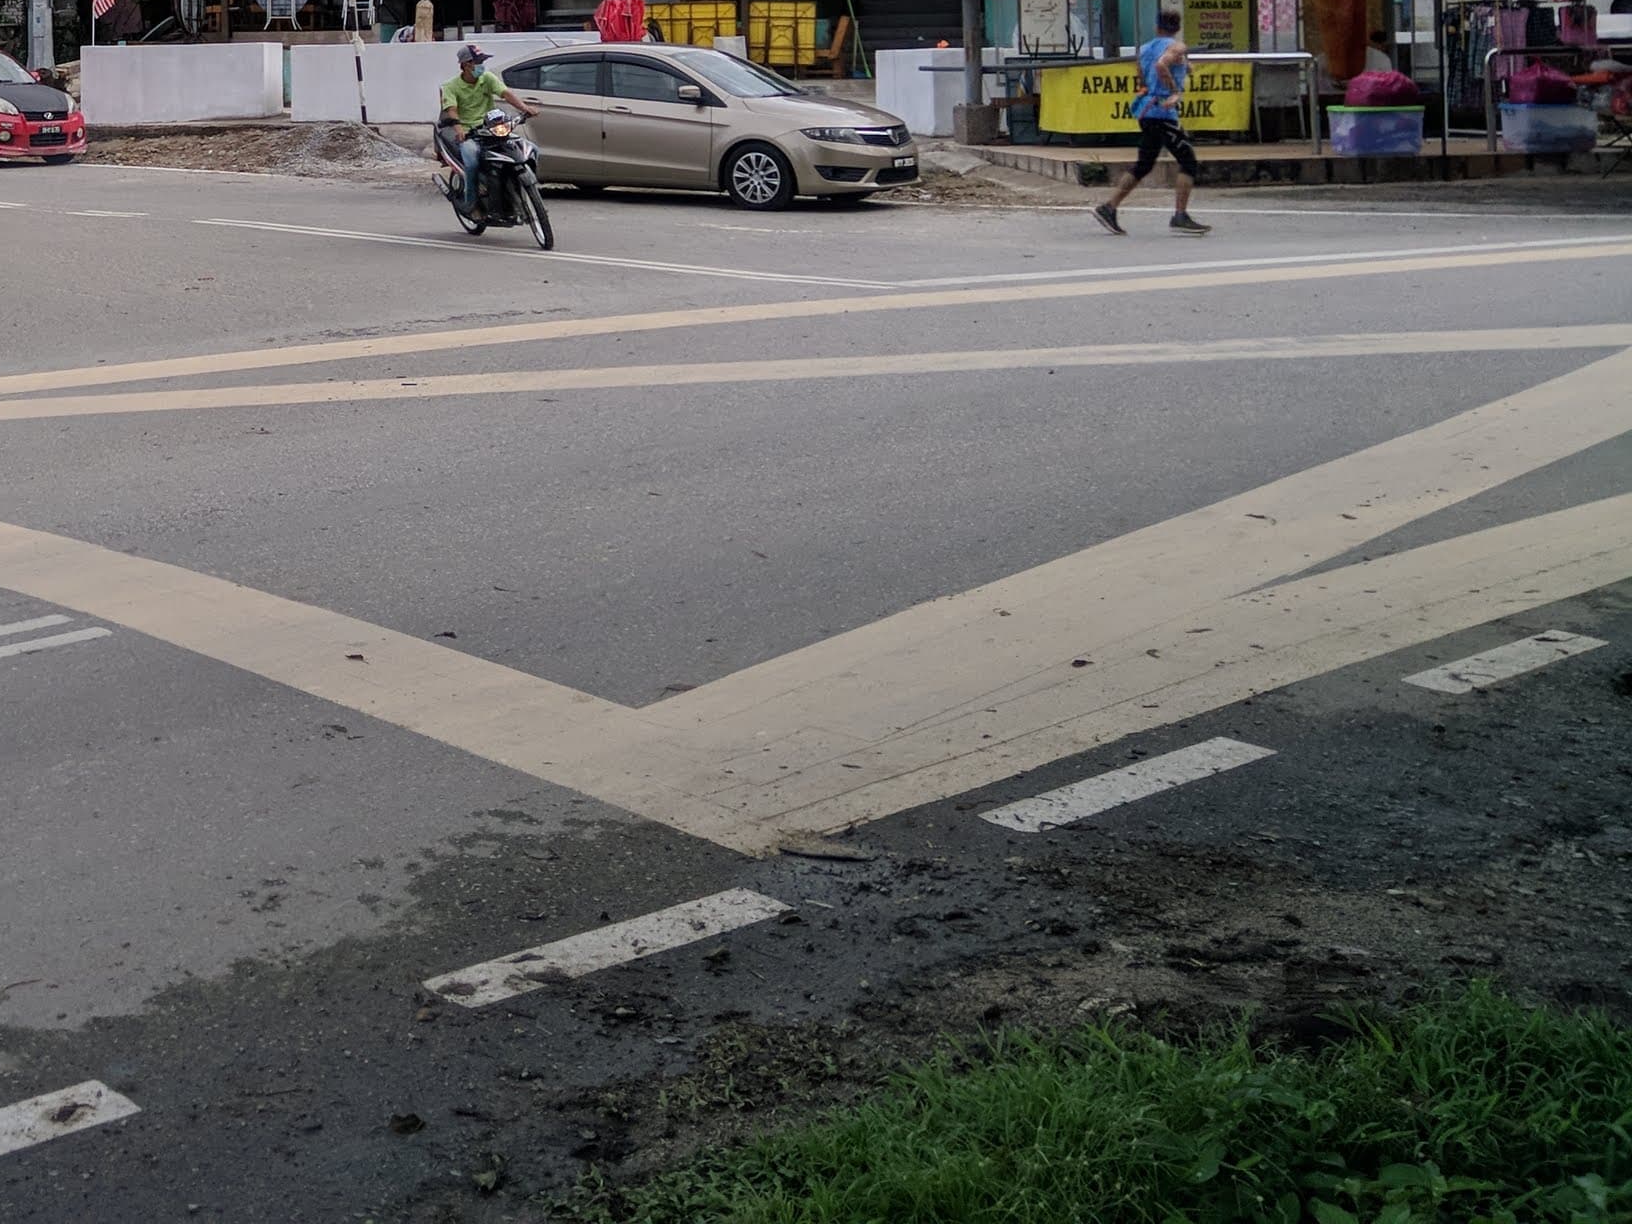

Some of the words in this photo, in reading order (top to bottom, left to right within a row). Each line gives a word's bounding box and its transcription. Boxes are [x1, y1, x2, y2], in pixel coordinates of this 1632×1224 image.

[1189, 1, 1218, 9] JANDA
[1221, 1, 1244, 9] BAIK
[1082, 76, 1129, 94] APAM
[1189, 74, 1244, 93] LELEH
